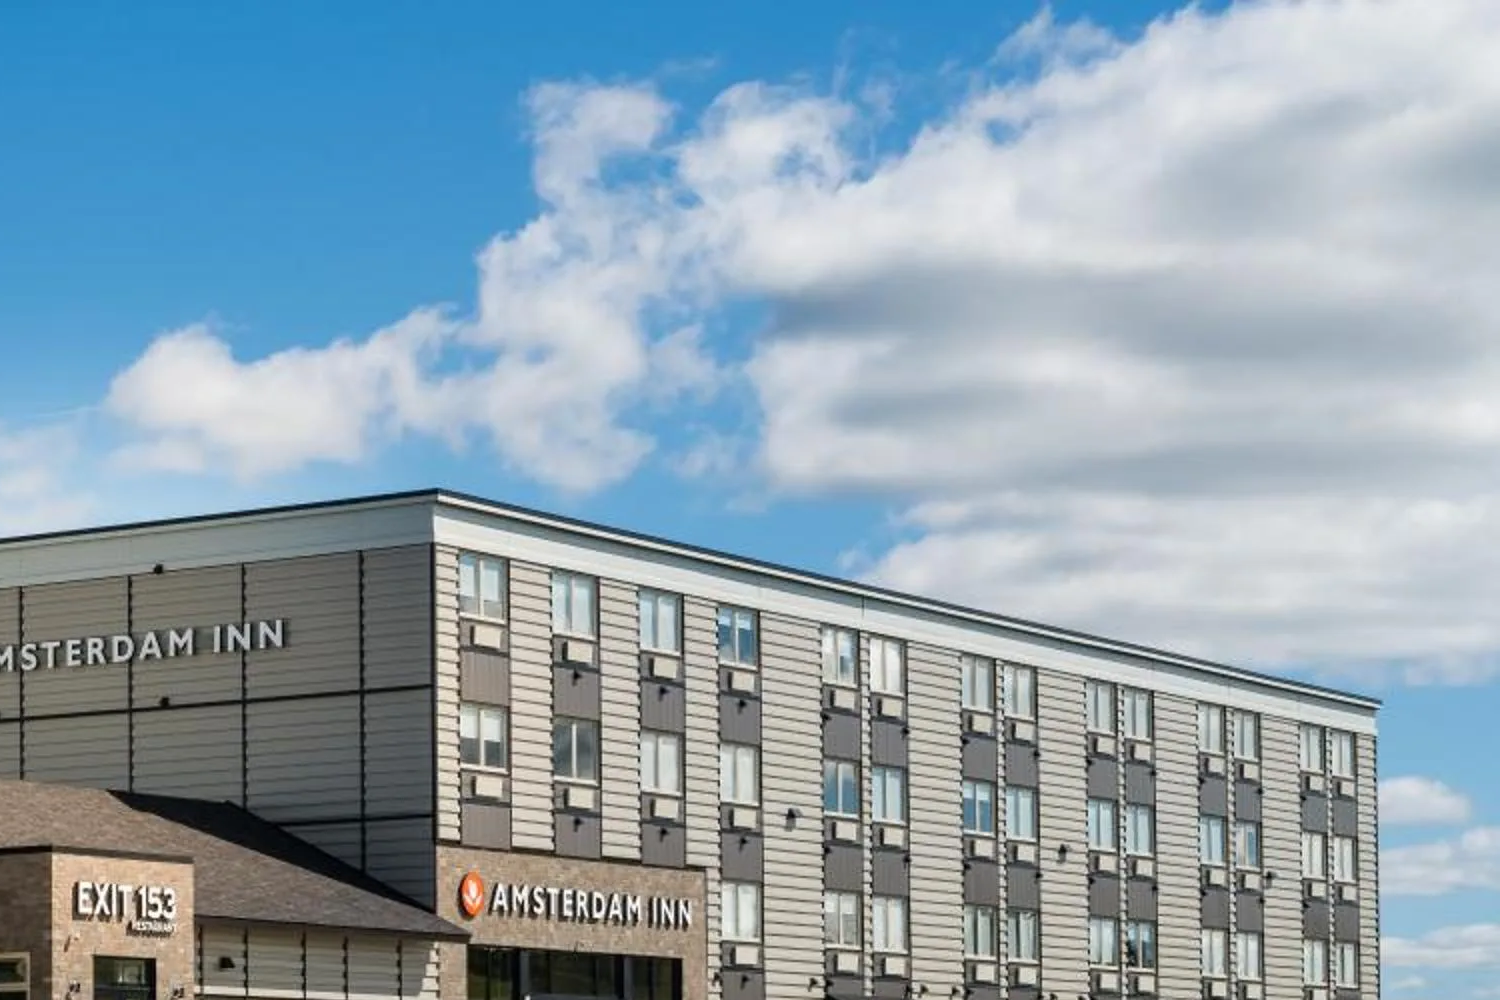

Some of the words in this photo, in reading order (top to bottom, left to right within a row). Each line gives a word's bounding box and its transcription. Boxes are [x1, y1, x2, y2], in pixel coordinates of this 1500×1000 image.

[213, 619, 284, 654] INN
[77, 881, 133, 916] EXIT
[138, 885, 177, 920] 153
[492, 883, 642, 923] AMSTERDAM
[652, 896, 693, 926] INN
